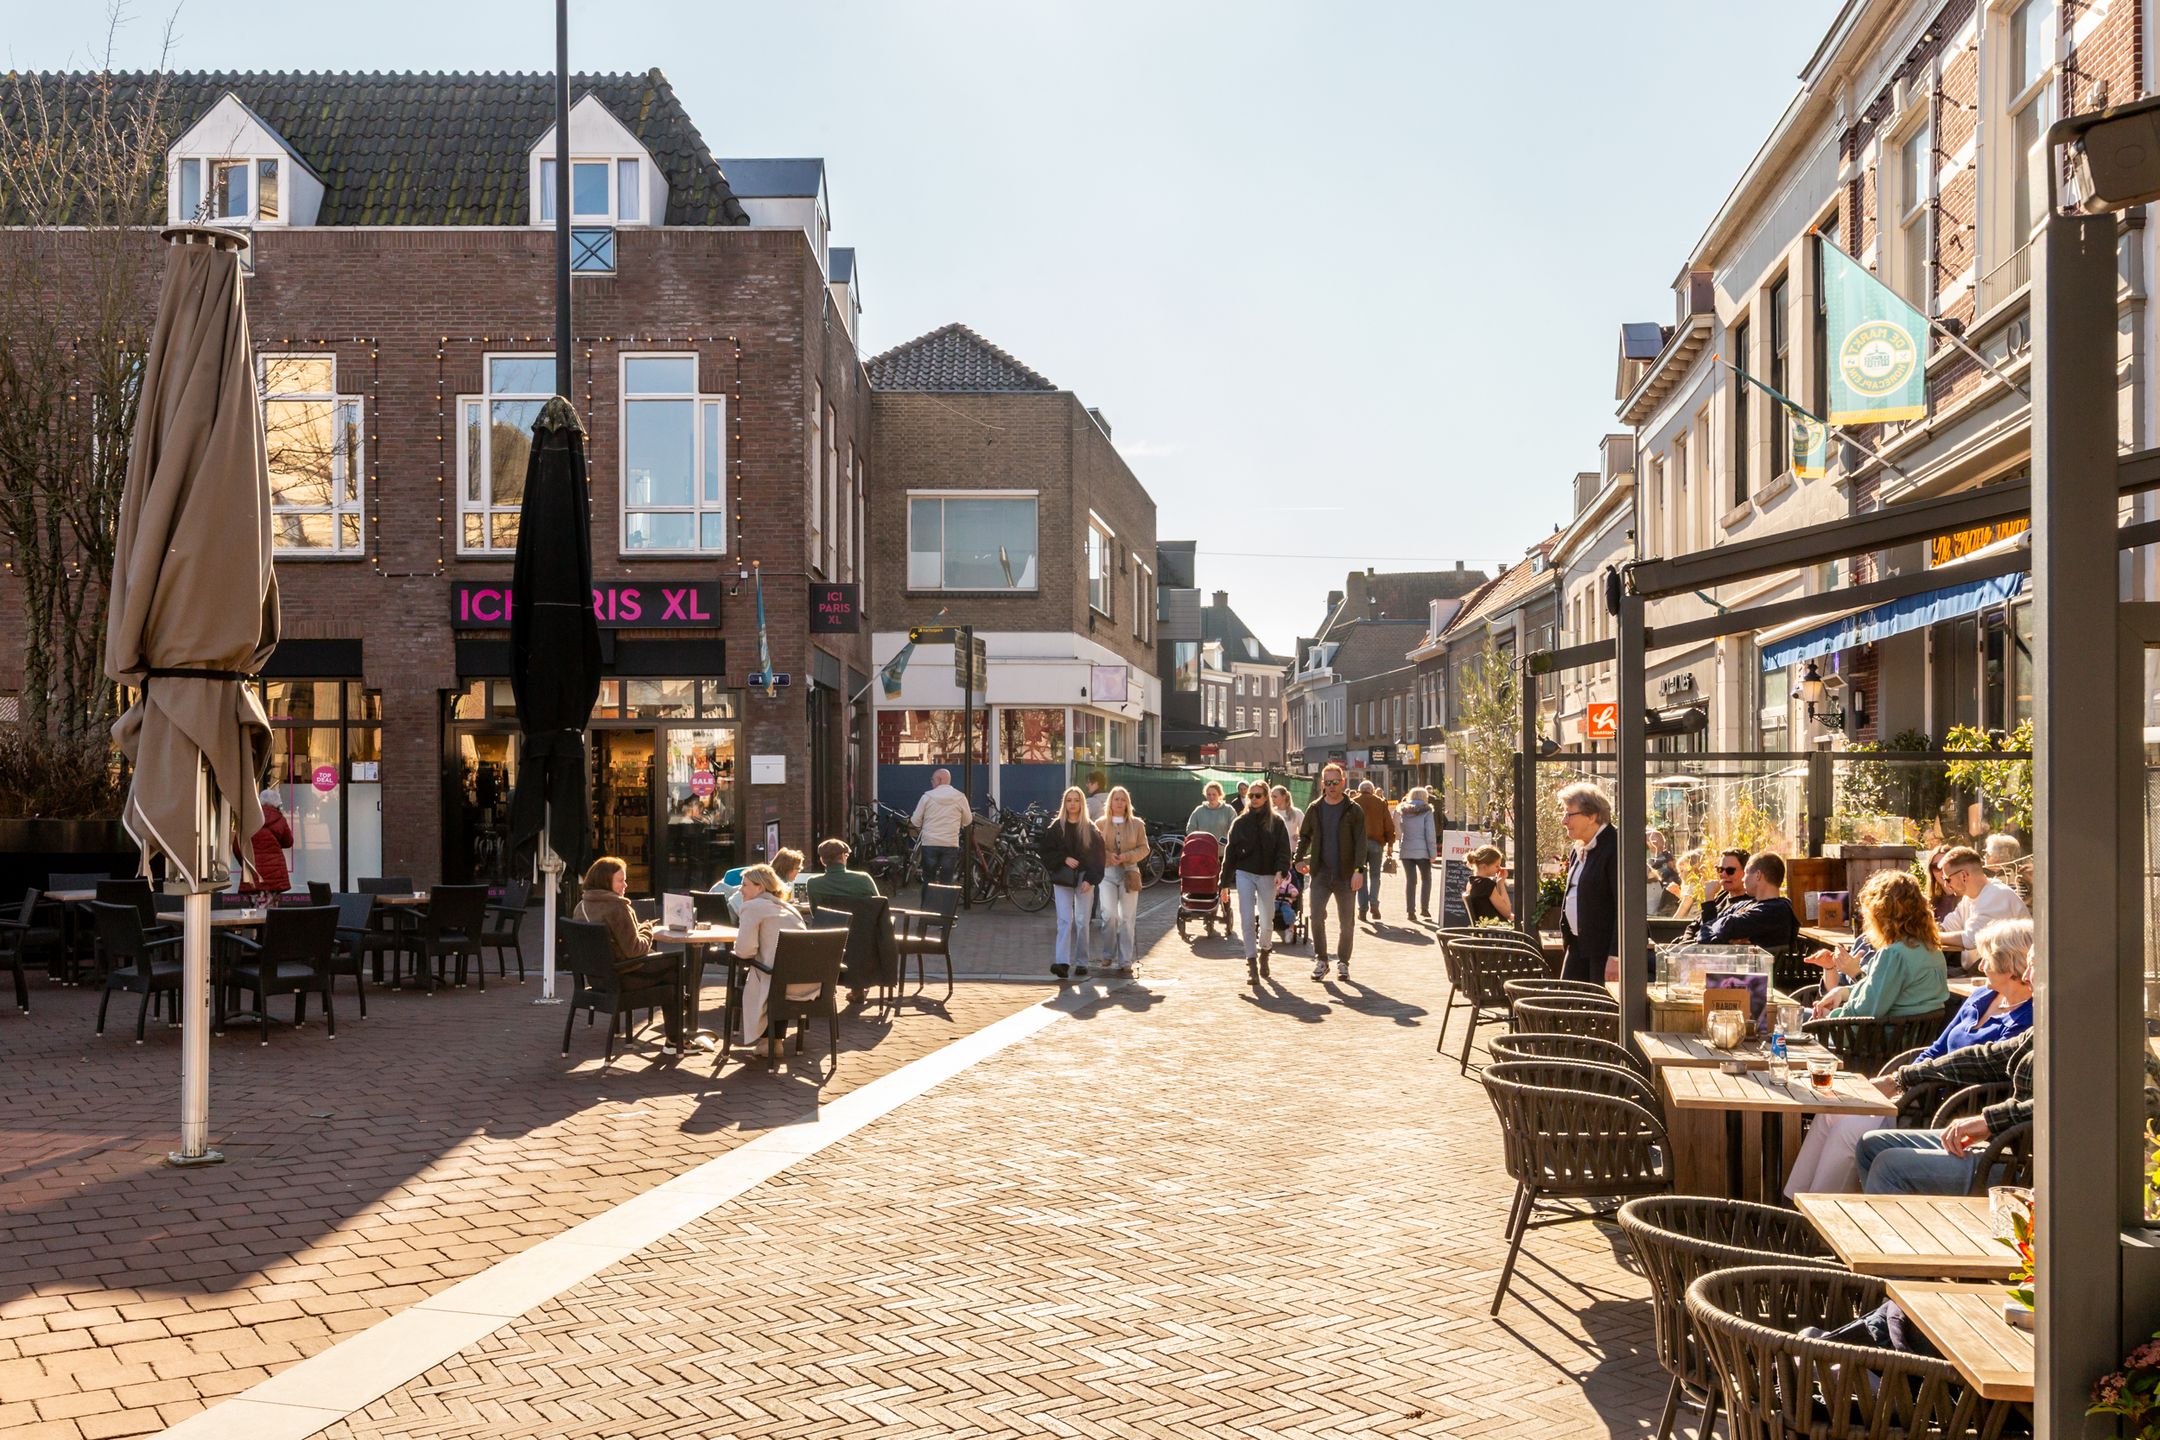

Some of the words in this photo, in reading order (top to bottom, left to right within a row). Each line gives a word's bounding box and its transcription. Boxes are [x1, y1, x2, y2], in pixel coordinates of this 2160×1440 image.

[827, 591, 842, 601] ICI
[592, 588, 642, 621] RIS
[661, 589, 710, 621] XL
[819, 603, 851, 613] PARIS
[828, 615, 842, 625] XL
